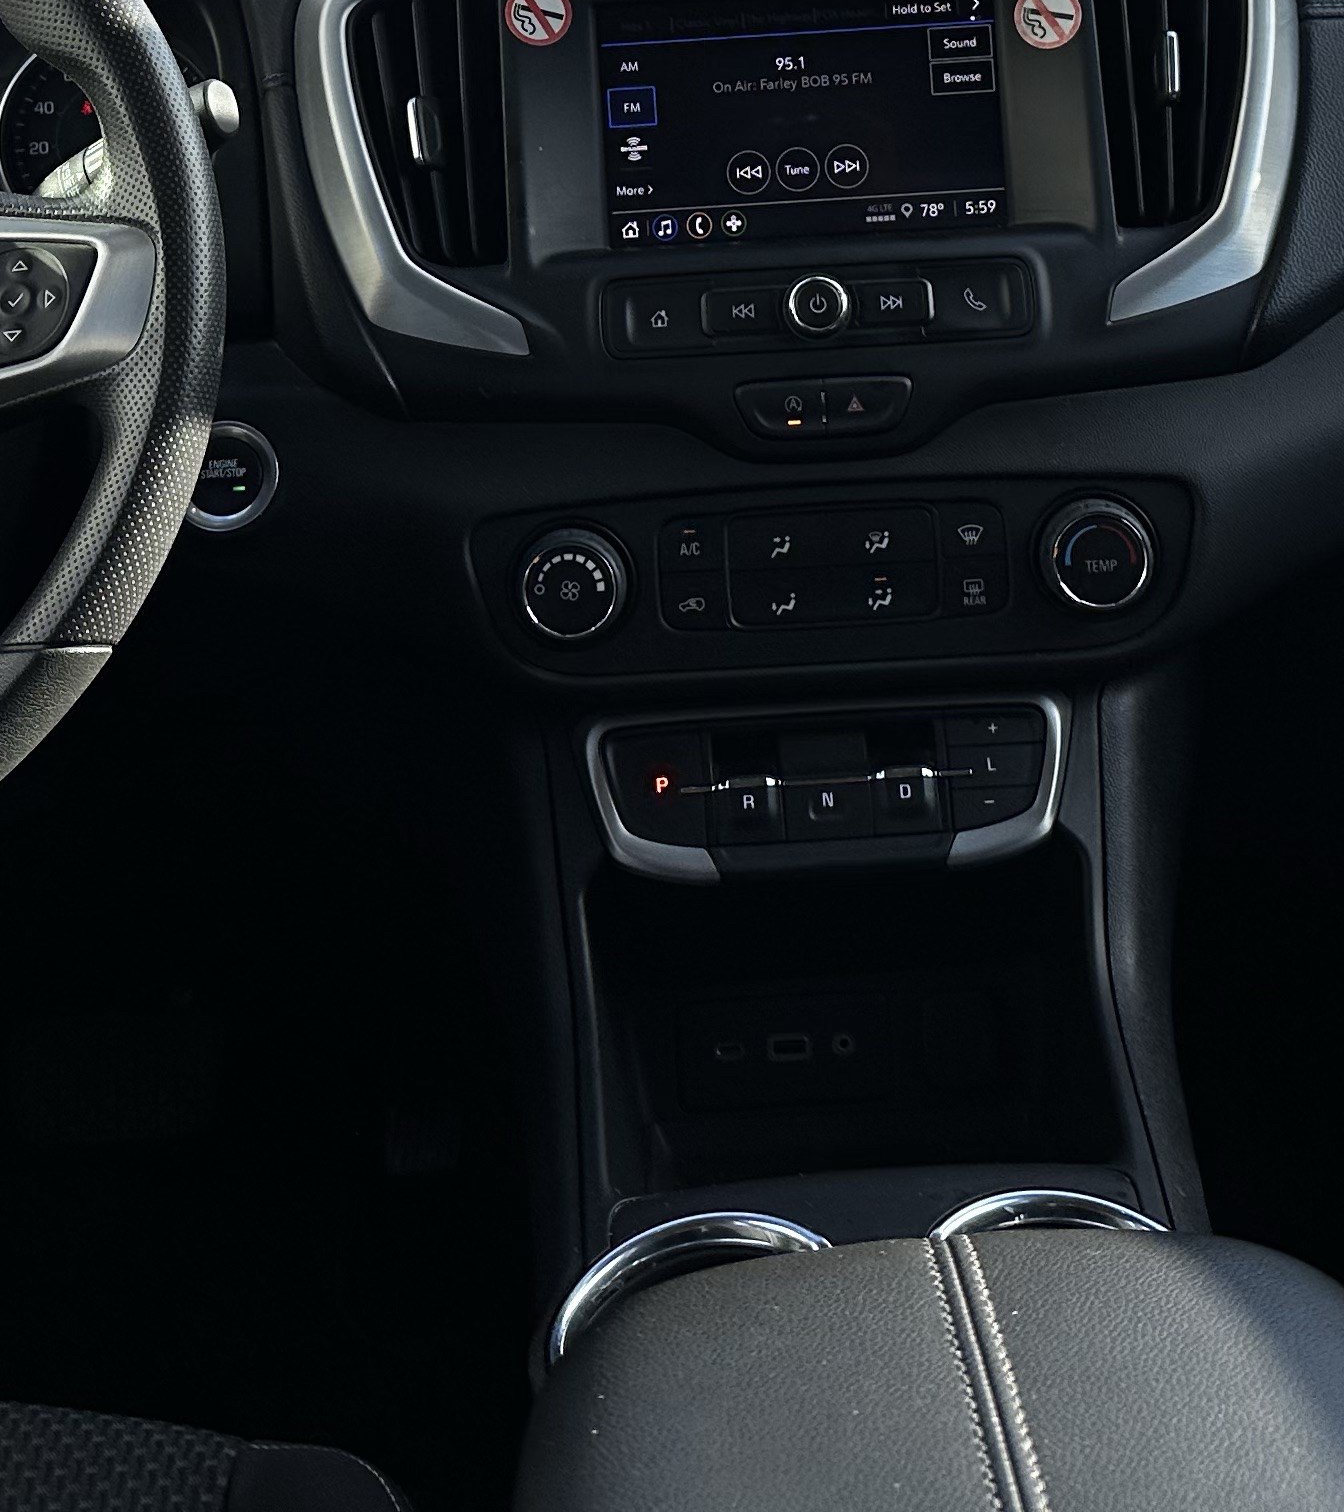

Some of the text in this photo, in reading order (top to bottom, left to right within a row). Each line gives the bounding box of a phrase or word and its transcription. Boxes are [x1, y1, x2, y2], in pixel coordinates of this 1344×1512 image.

[892, 1, 952, 16] Hold to Set
[943, 36, 977, 49] Sound
[620, 61, 639, 73] AM
[775, 55, 806, 71] 95.1
[712, 72, 873, 93] On Air: Farley BOB 95 FM
[943, 71, 982, 84] Browse
[34, 100, 54, 115] 40
[623, 101, 640, 114] FM
[28, 140, 49, 155] 20
[784, 163, 810, 176] Tune
[616, 185, 645, 197] More
[866, 203, 893, 213] 4G LTE
[919, 202, 944, 216] 78°
[964, 200, 996, 215] 5:59
[208, 458, 238, 469] ENGINE
[200, 466, 247, 479] START/STOP
[679, 541, 700, 557] A/C
[1085, 558, 1118, 575] TEMP
[962, 592, 987, 606] REAR
[986, 757, 996, 771] L
[656, 776, 668, 793] P
[899, 784, 911, 799] D
[743, 794, 754, 809] R
[821, 792, 833, 807] N
